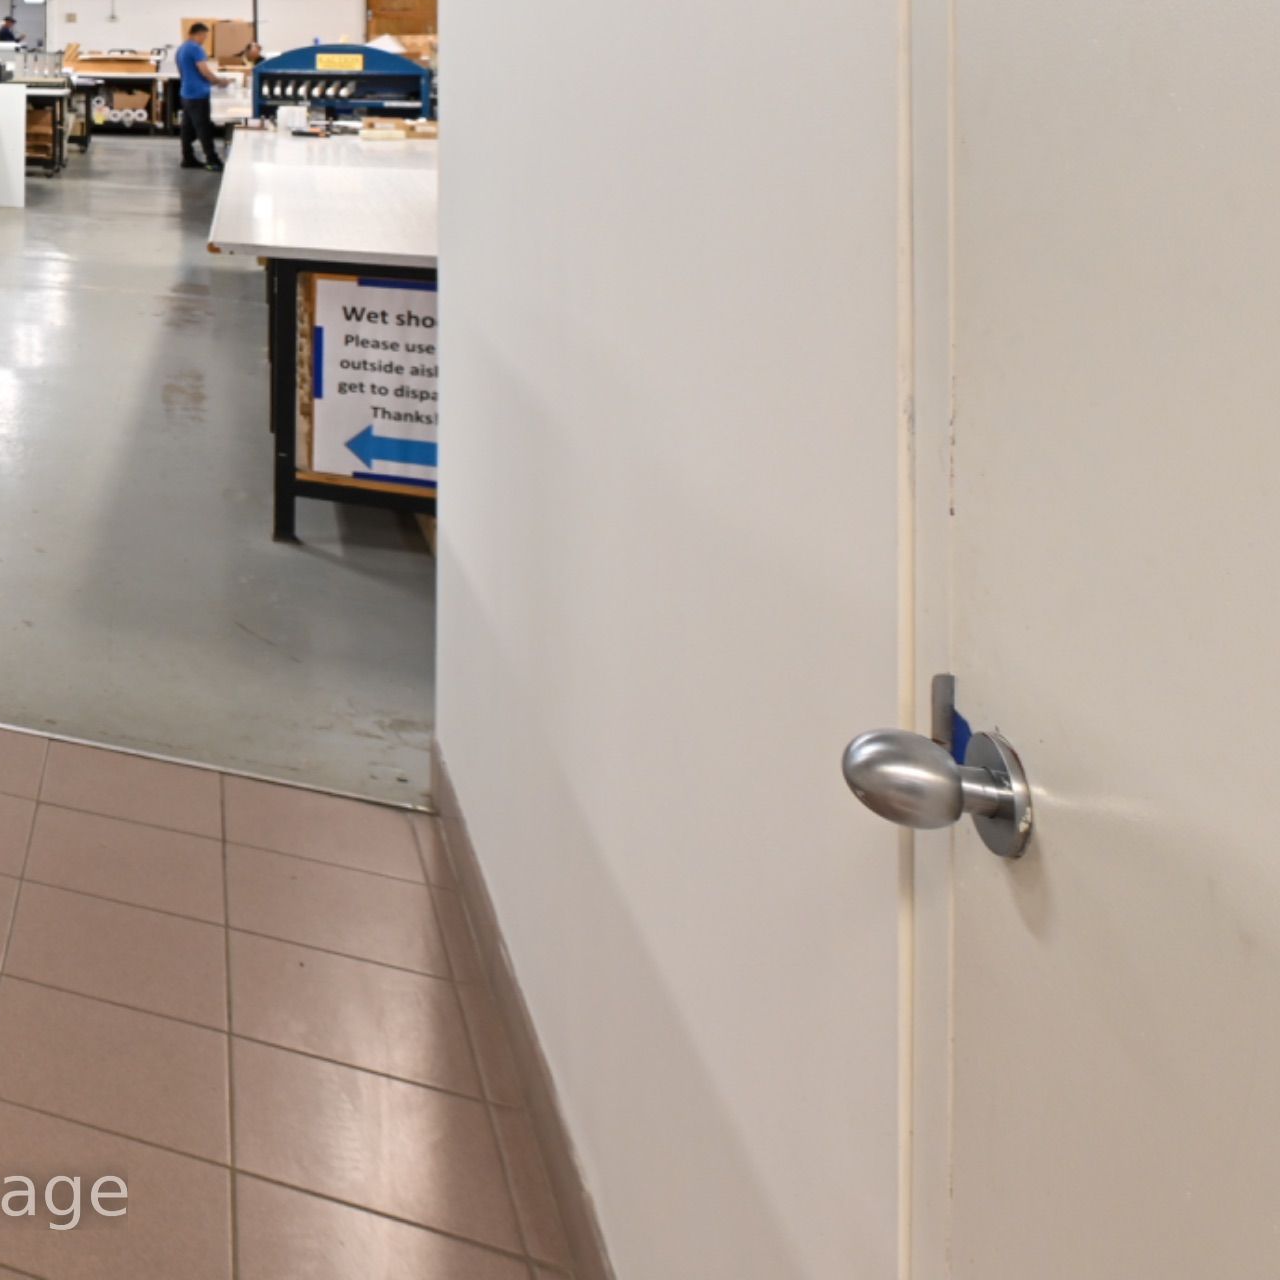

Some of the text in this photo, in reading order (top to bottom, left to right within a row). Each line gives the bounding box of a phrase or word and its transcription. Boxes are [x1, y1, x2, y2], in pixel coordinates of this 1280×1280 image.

[342, 306, 437, 328] Wet sho
[344, 334, 436, 355] Please use
[340, 359, 405, 376] outside
[338, 381, 365, 395] get
[370, 383, 389, 396] to
